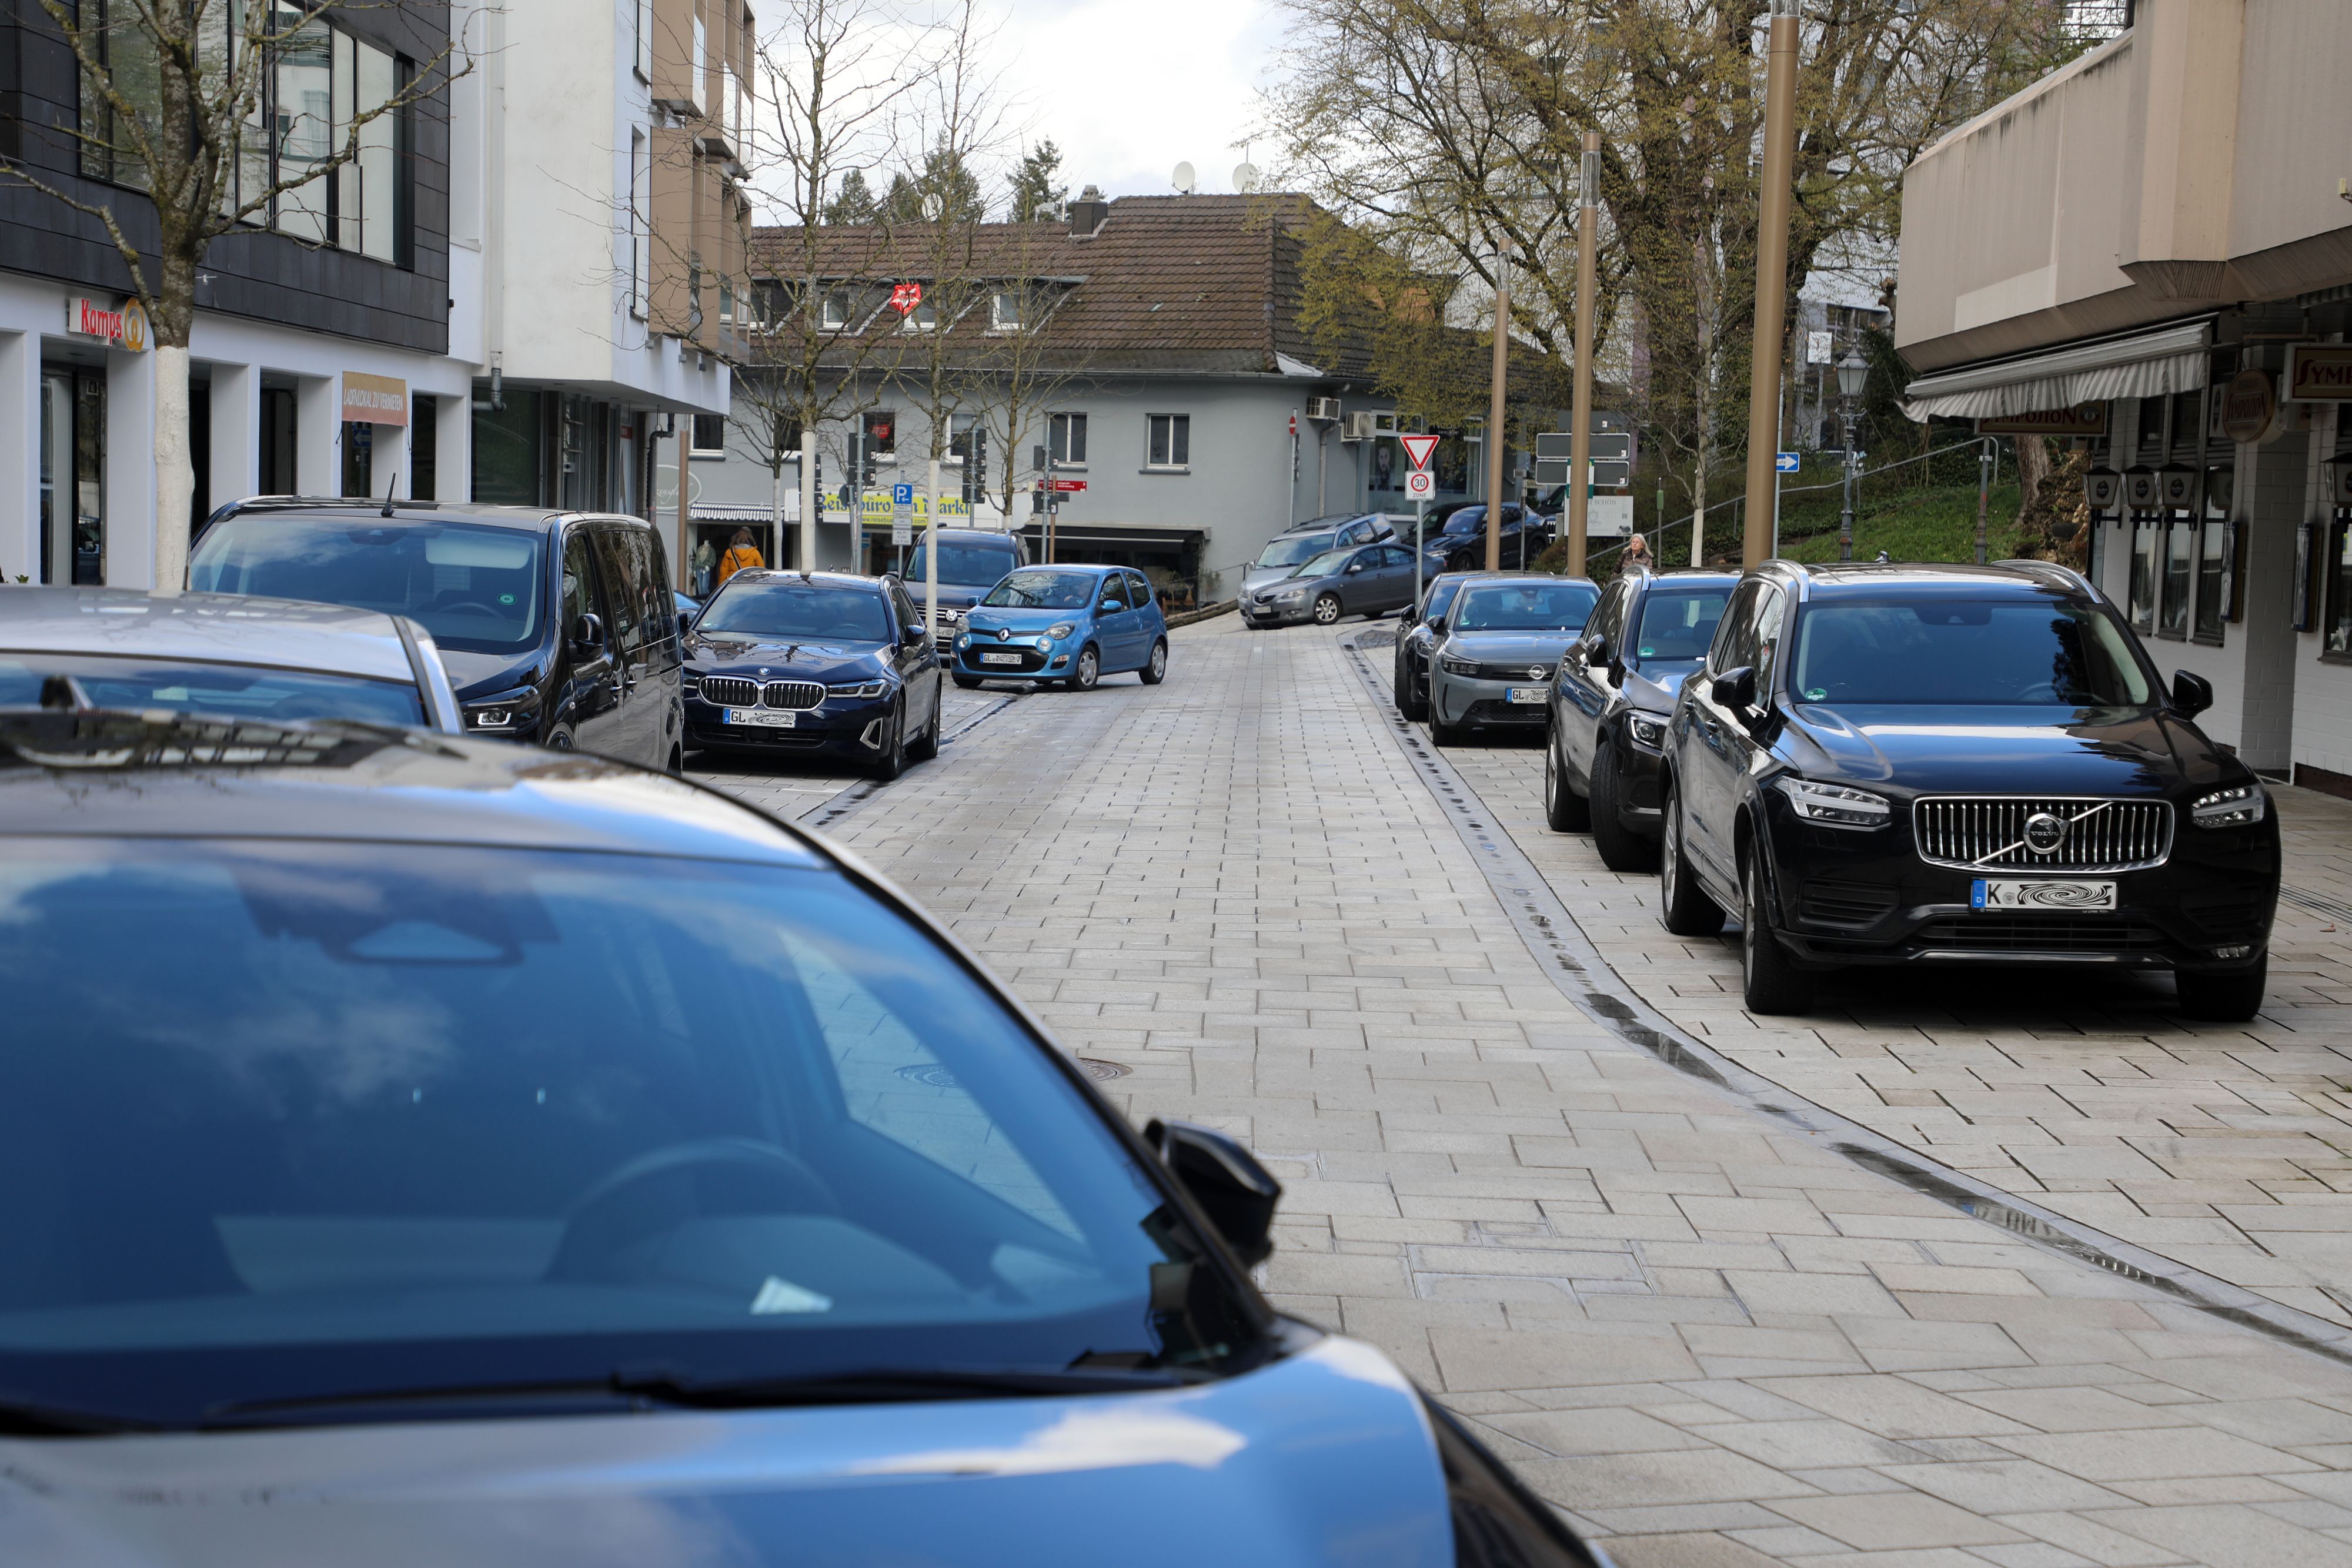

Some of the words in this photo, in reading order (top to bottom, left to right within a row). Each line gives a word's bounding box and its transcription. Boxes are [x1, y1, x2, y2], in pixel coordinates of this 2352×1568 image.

[81, 299, 122, 346] Kamps
[343, 388, 372, 407] LADENLOKAL
[372, 391, 379, 409] ZU
[379, 392, 403, 412] VERMIETEN
[1414, 479, 1425, 487] 30
[896, 486, 907, 502] P
[1513, 690, 1524, 700] GL
[731, 711, 746, 723] GL
[1987, 884, 2002, 904] K
